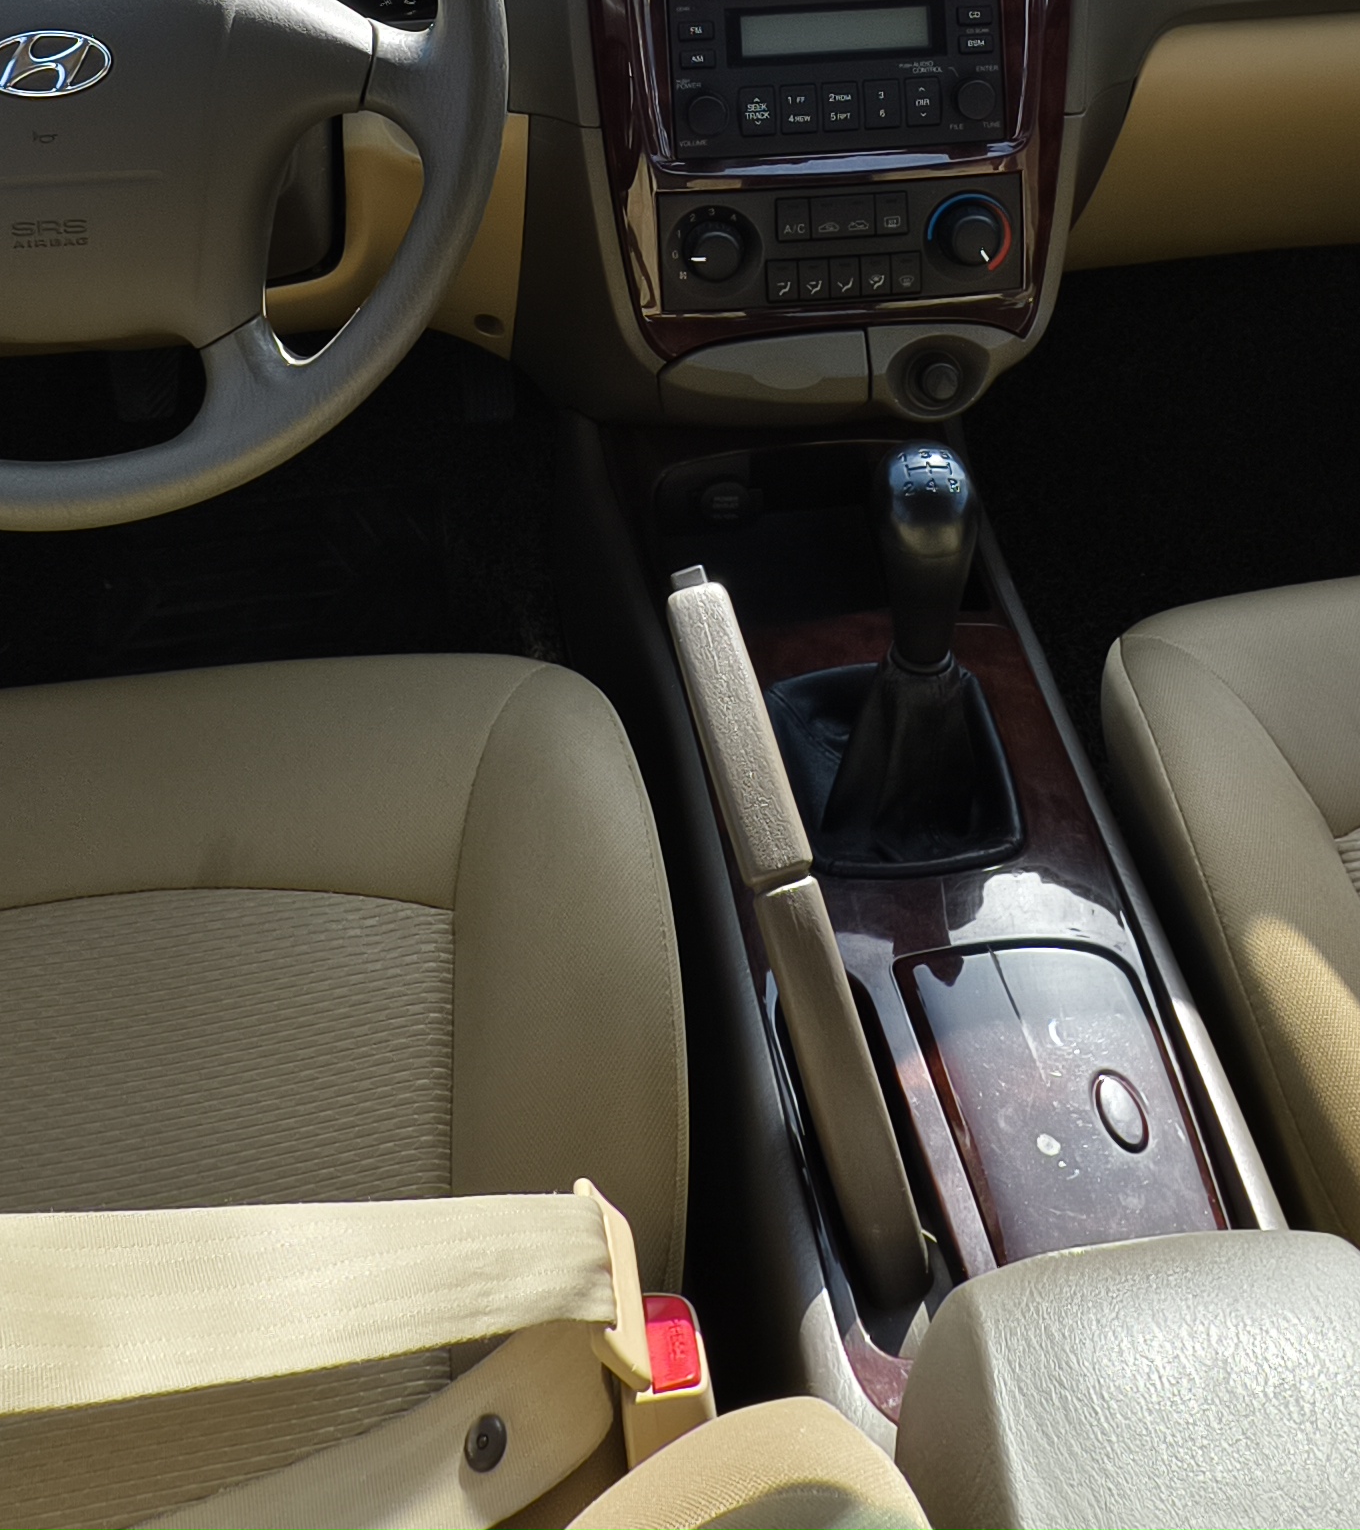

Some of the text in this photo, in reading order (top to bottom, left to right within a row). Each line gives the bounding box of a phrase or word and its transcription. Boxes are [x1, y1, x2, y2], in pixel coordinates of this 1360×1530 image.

[745, 111, 770, 120] TRACK
[11, 220, 88, 237] SRS
[783, 223, 806, 235] A/C
[13, 237, 89, 249] AIRBAG
